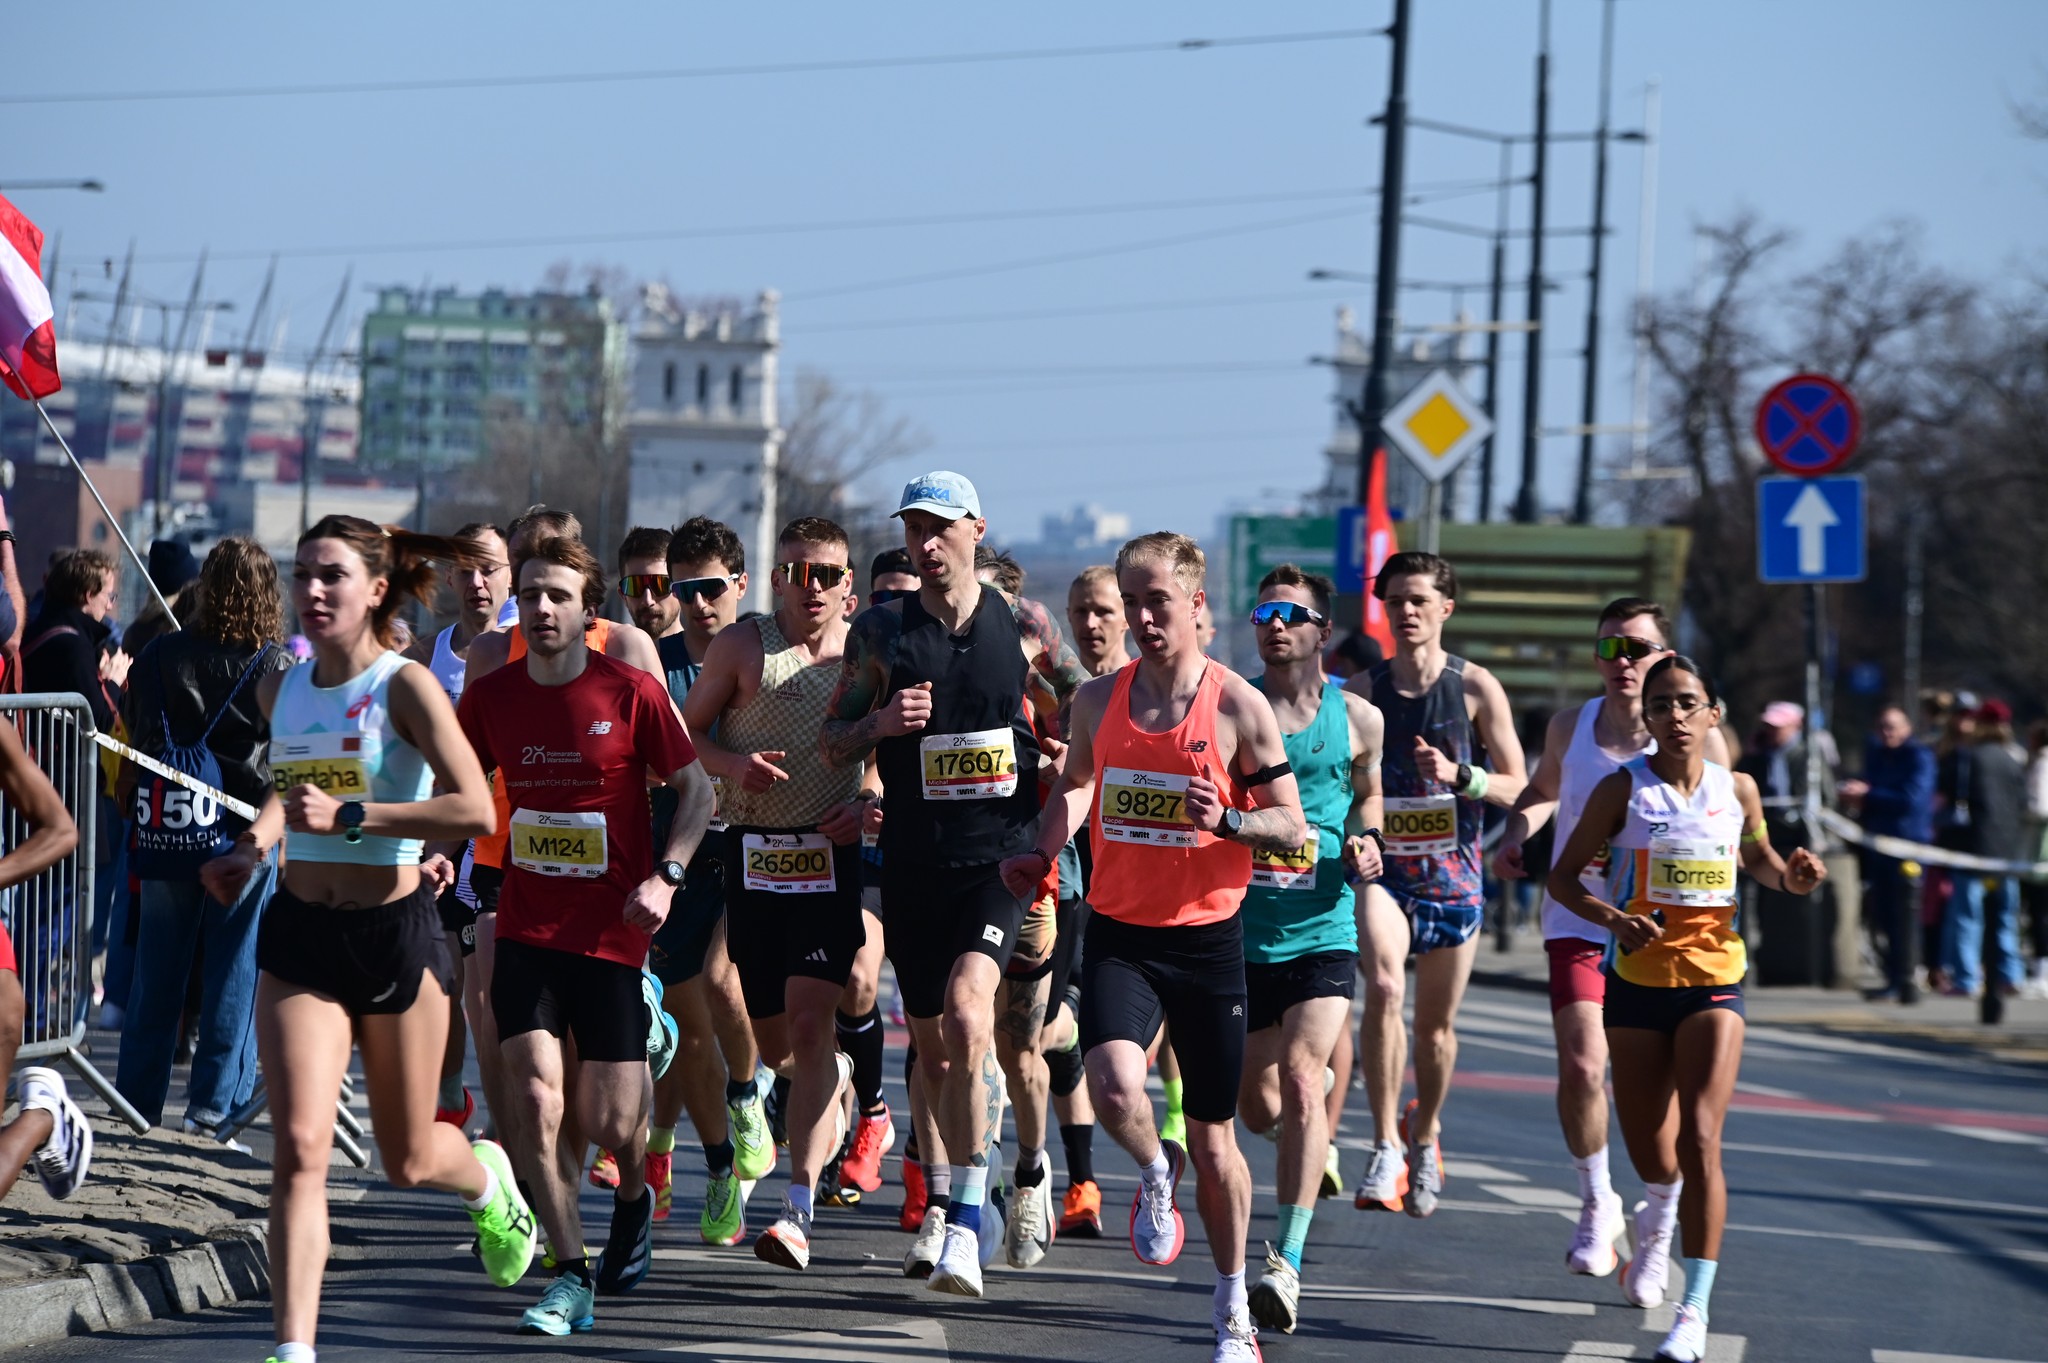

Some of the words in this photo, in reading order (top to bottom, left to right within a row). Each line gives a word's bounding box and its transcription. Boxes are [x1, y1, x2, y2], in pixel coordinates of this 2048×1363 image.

[908, 487, 950, 502] HOKA
[934, 749, 1005, 776] 17607
[573, 779, 598, 787] Runner
[1116, 790, 1182, 819] 9827
[1384, 812, 1449, 833] 10065
[529, 836, 586, 858] M124
[750, 852, 826, 874] 26500
[1662, 864, 1725, 885] Torres
